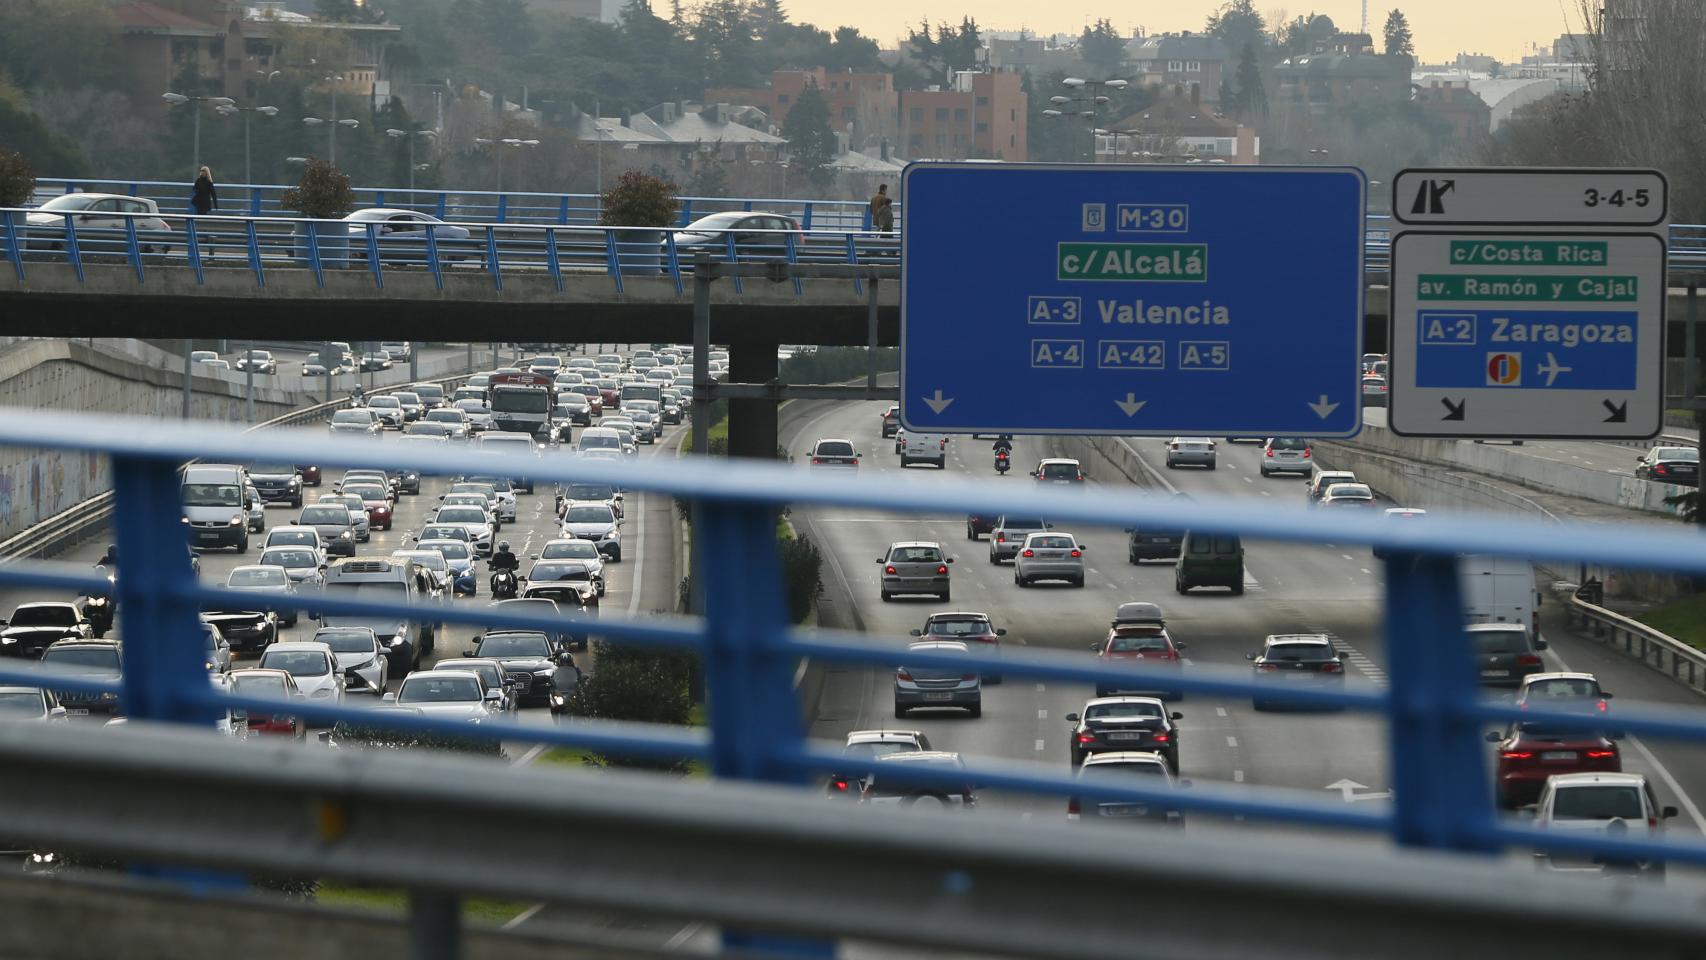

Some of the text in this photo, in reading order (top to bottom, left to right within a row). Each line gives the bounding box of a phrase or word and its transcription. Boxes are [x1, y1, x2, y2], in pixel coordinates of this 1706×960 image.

[1584, 189, 1649, 207] 3-4-5
[1122, 209, 1184, 228] M-30
[1063, 250, 1202, 274] c/Alcalá
[1455, 244, 1602, 261] c/Costa Rica
[1419, 279, 1634, 299] av. Ramón y Cajal
[1034, 300, 1230, 324] A-3 Valencia
[1428, 318, 1632, 347] A-2 Zaragoza
[1036, 344, 1225, 364] A-4 A-42 A-5
